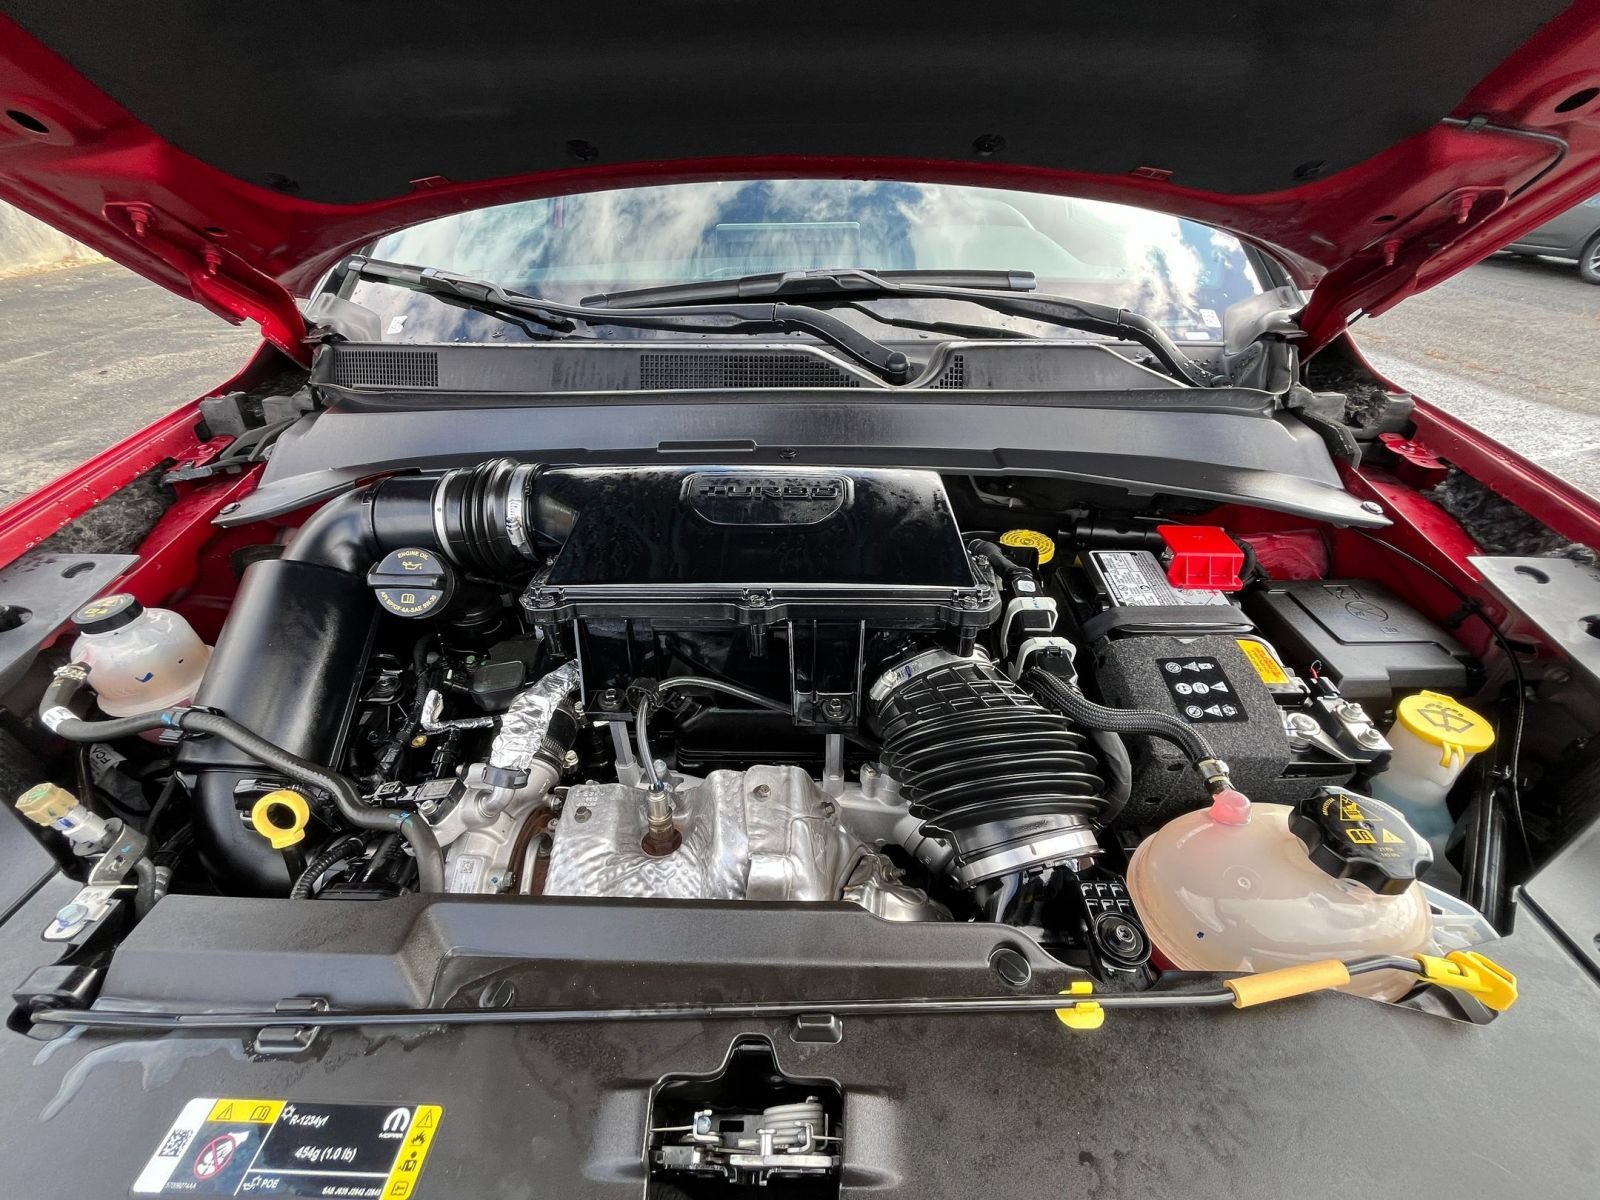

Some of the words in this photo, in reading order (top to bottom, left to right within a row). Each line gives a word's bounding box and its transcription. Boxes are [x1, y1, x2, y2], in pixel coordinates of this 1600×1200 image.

[699, 485, 838, 501] TURBO
[397, 551, 419, 559] ENGINE
[419, 551, 429, 561] OIL
[294, 1145, 322, 1162] 454g
[319, 1146, 343, 1162] (1.0
[340, 1147, 358, 1163] lb)
[260, 1178, 280, 1189] POE
